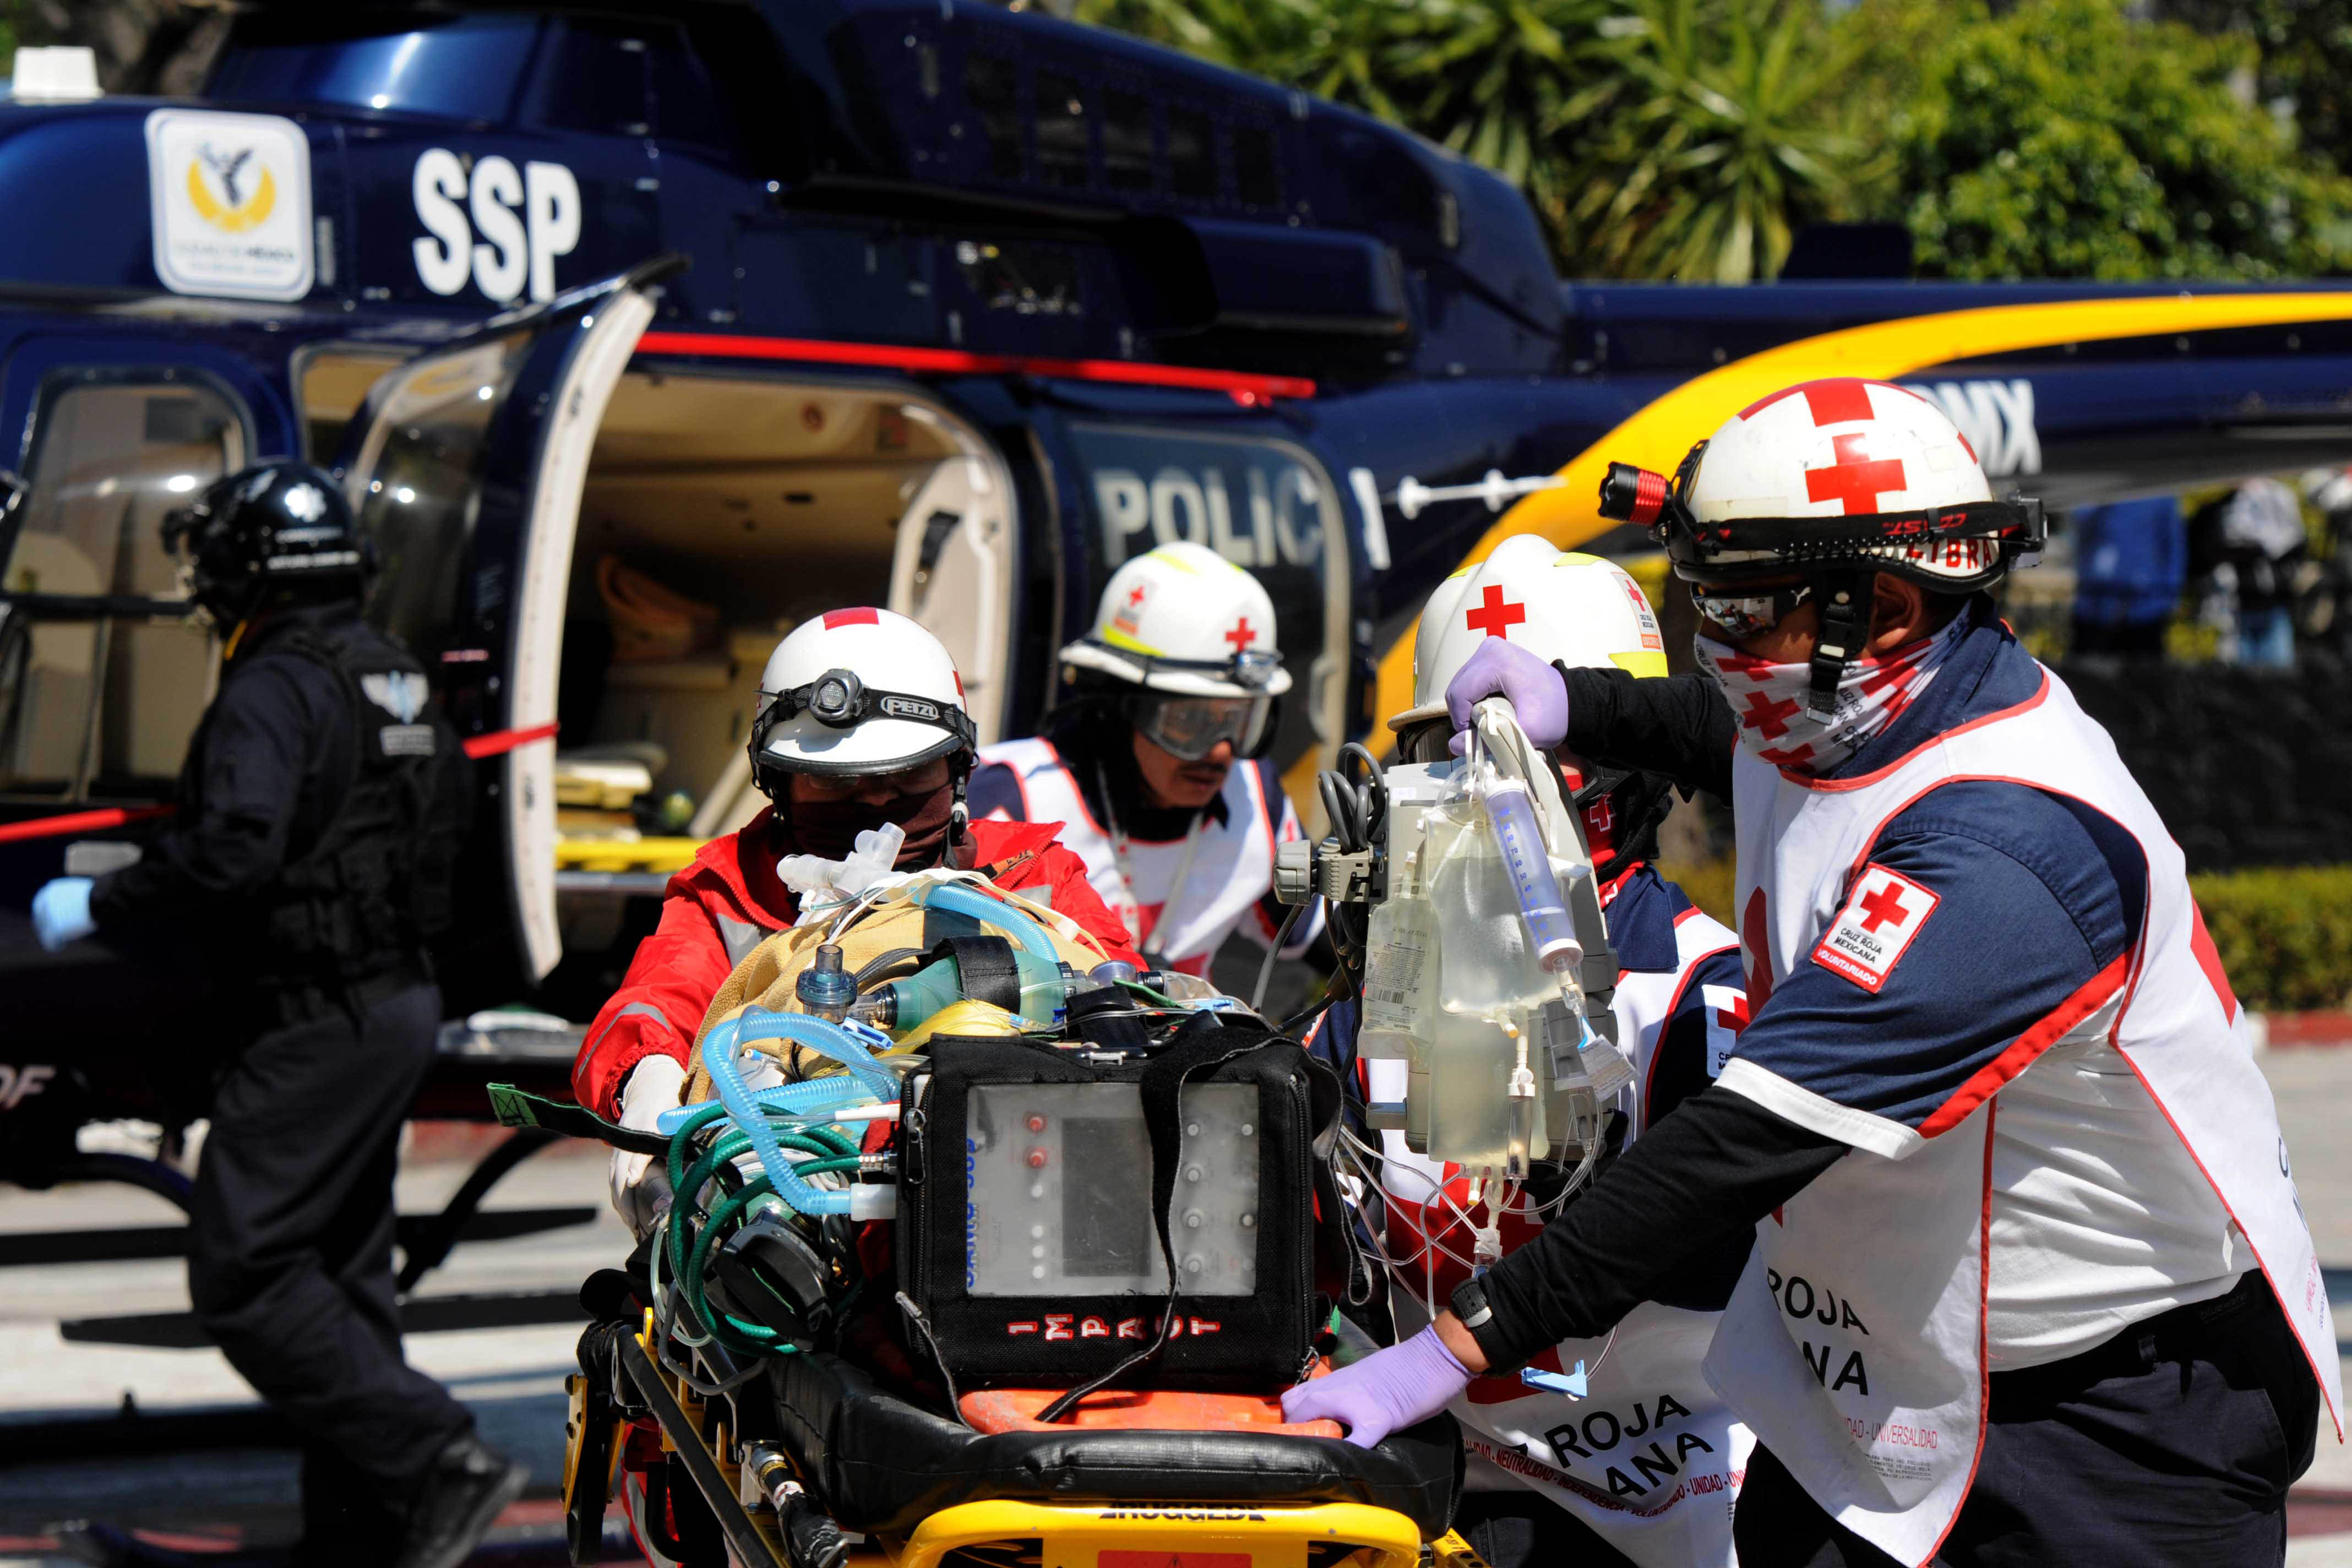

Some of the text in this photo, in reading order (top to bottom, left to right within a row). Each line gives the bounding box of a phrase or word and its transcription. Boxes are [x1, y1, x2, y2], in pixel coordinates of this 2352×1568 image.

[413, 149, 582, 304] SSP
[888, 699, 934, 716] PETZL
[1834, 937, 1876, 963] MEXICANA
[1840, 927, 1882, 955] CRUZ ROJA
[1817, 949, 1877, 986] VOLUNTARIADO
[1545, 1394, 1692, 1468] ROJA
[1872, 1422, 1939, 1450] UNIVERSALIDAD
[1496, 1449, 1555, 1482] NEUTRALIDAD
[1689, 1473, 1723, 1496] UNIDAD
